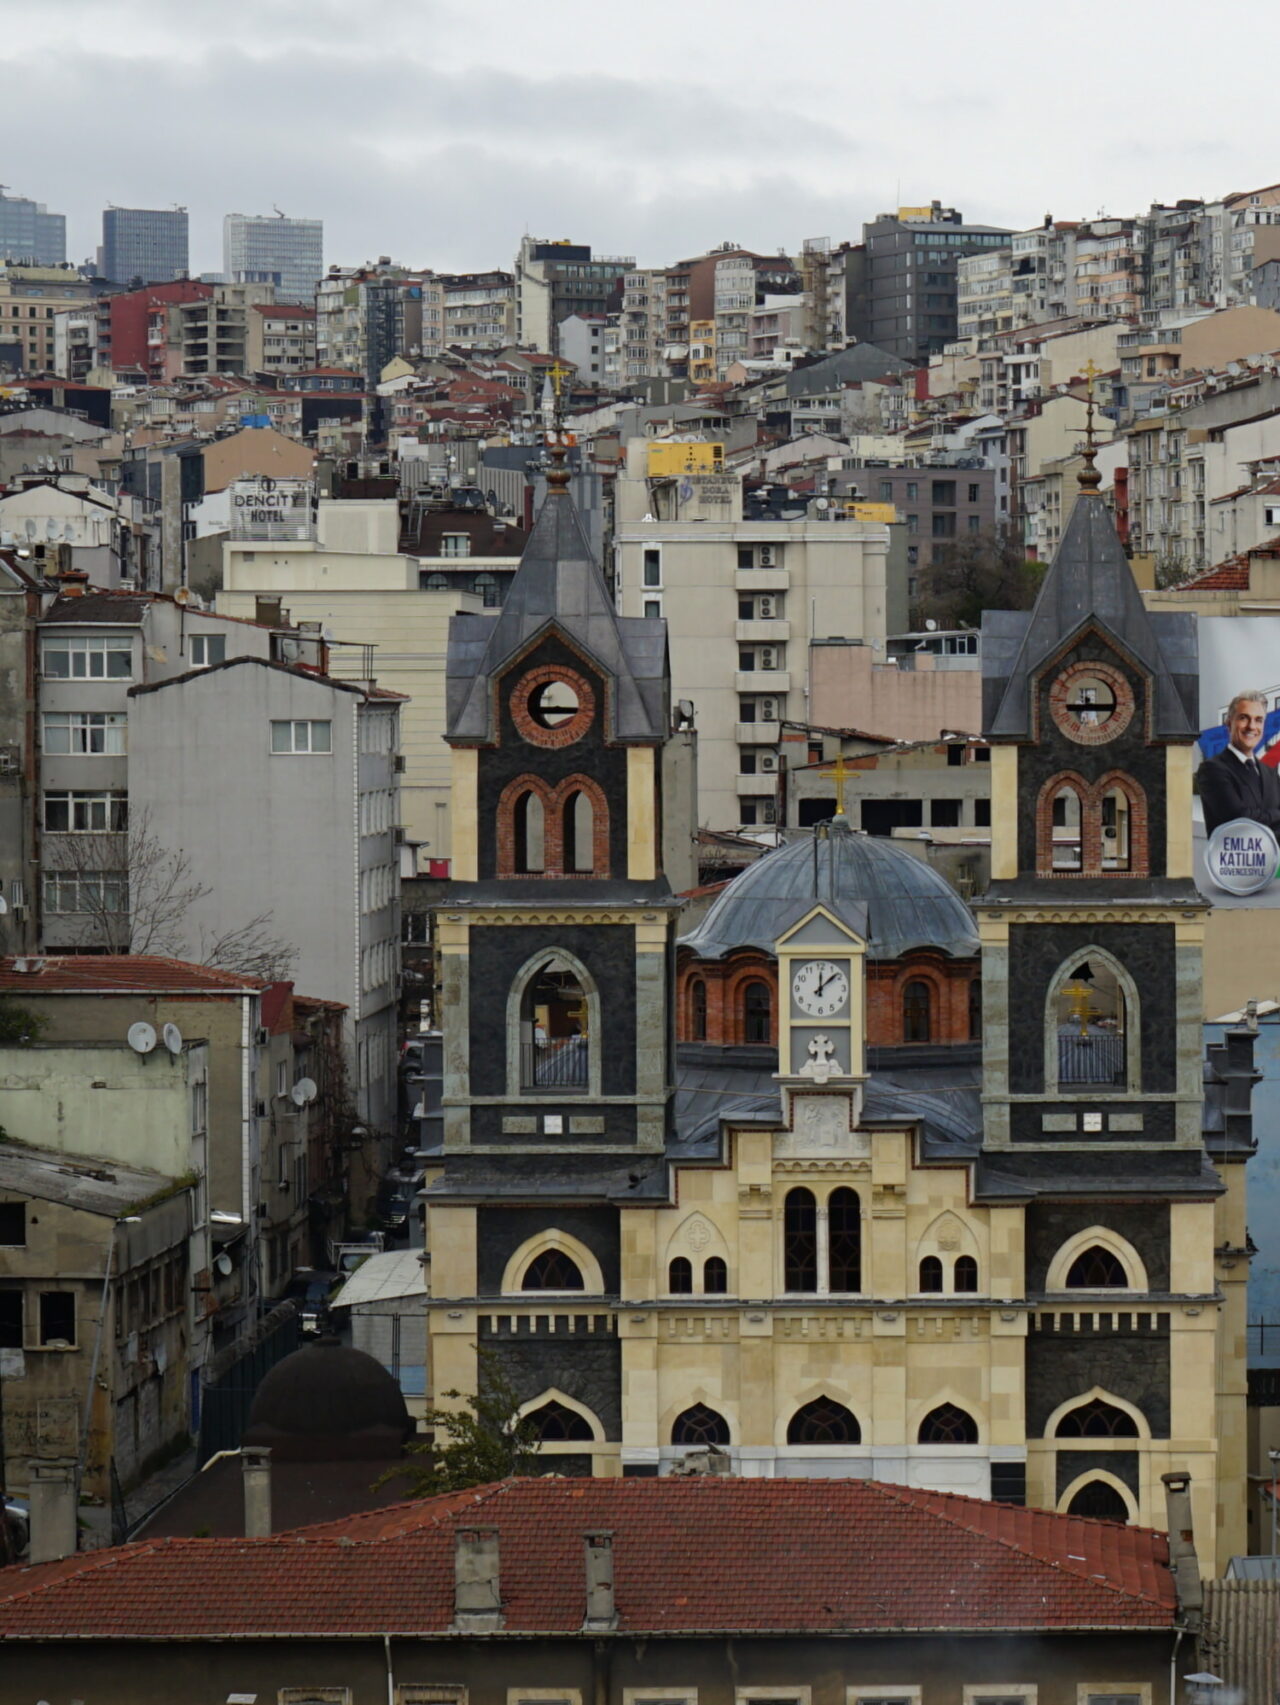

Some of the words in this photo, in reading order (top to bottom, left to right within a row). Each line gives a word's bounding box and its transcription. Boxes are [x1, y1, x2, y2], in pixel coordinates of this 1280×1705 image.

[234, 495, 299, 507] DENCITY
[251, 510, 284, 522] HOTEL
[1223, 837, 1262, 851] EMLAK
[1220, 852, 1266, 867] KATILIM
